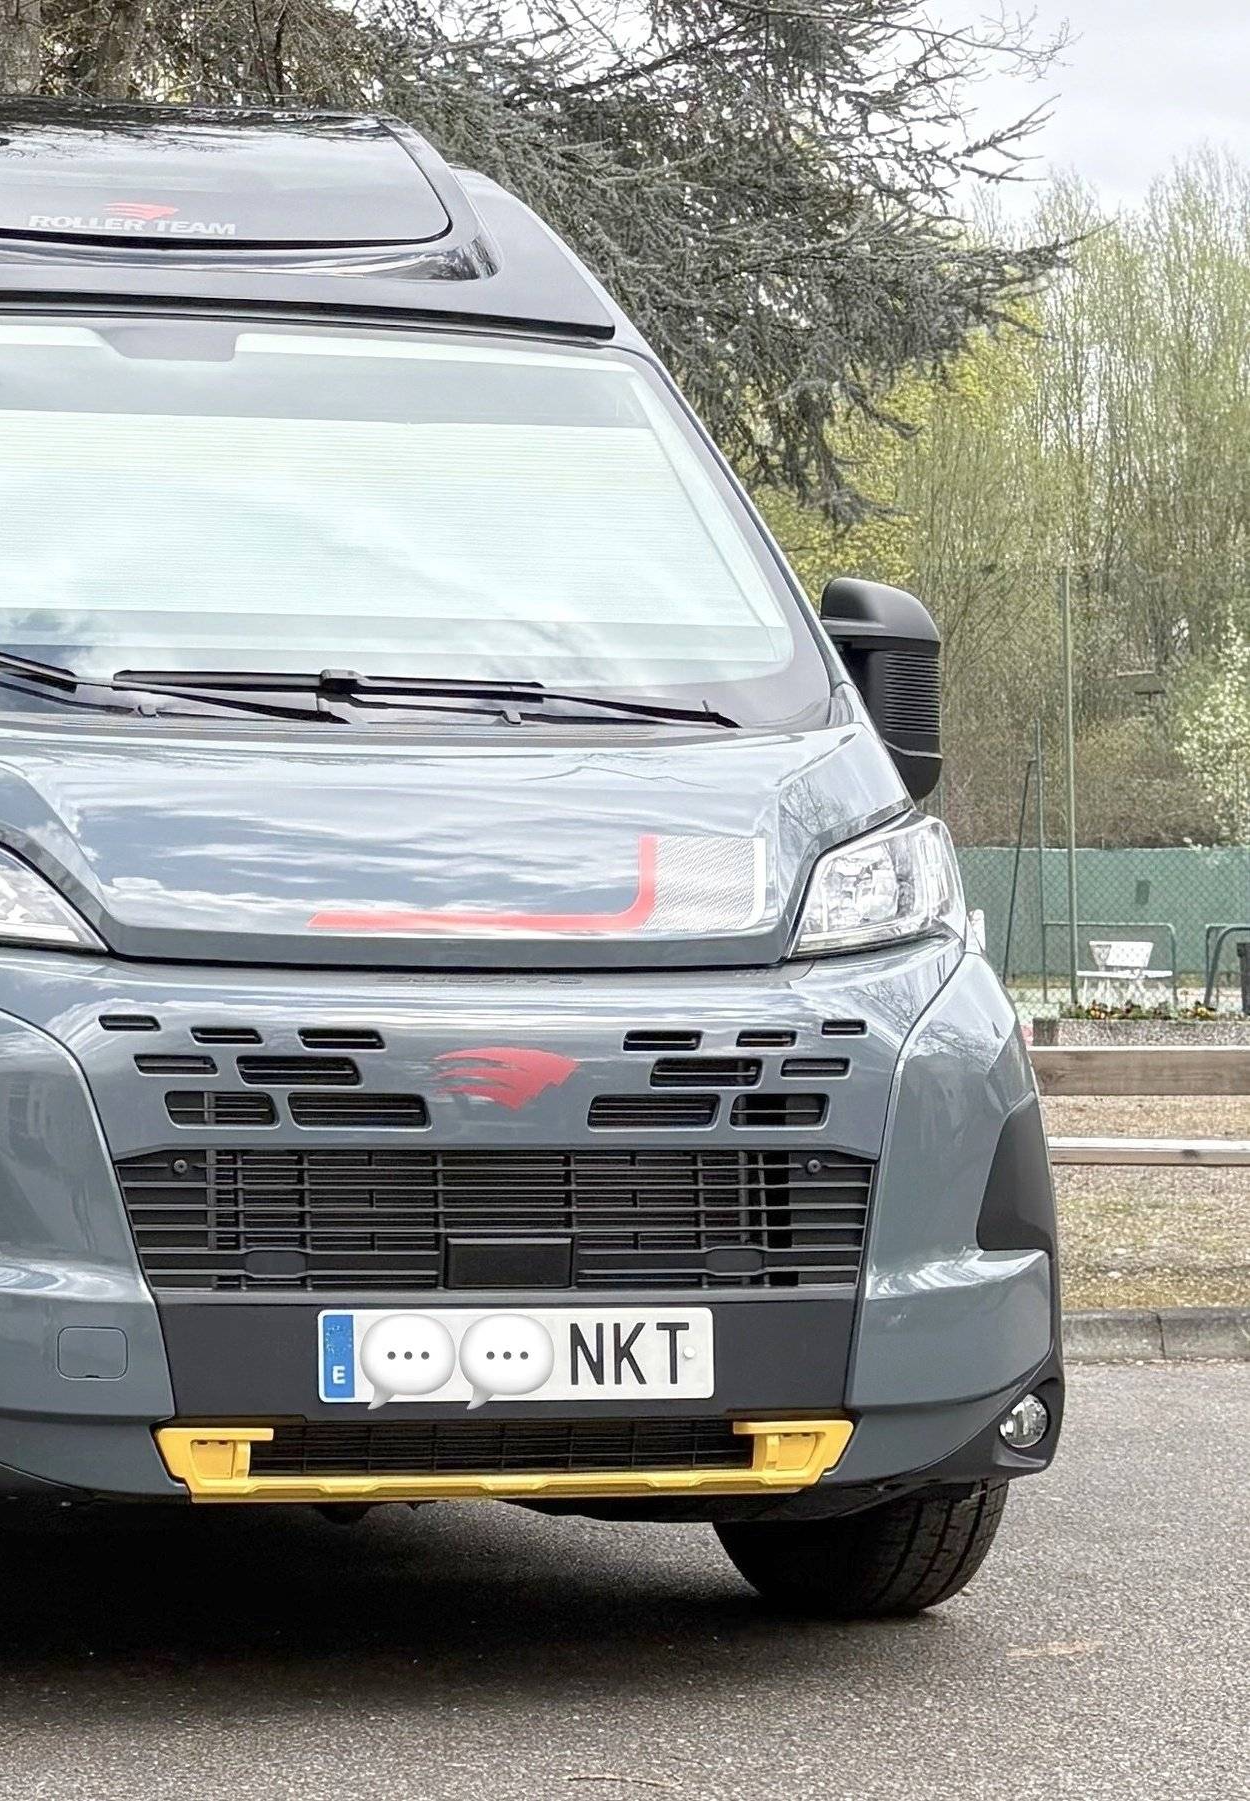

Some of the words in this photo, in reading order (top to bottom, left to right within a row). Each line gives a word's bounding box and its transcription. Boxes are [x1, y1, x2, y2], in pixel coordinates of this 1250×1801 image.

[28, 214, 145, 232] ROLLER
[154, 219, 237, 236] TEAM
[569, 1321, 691, 1386] NKT
[332, 1365, 347, 1385] E
